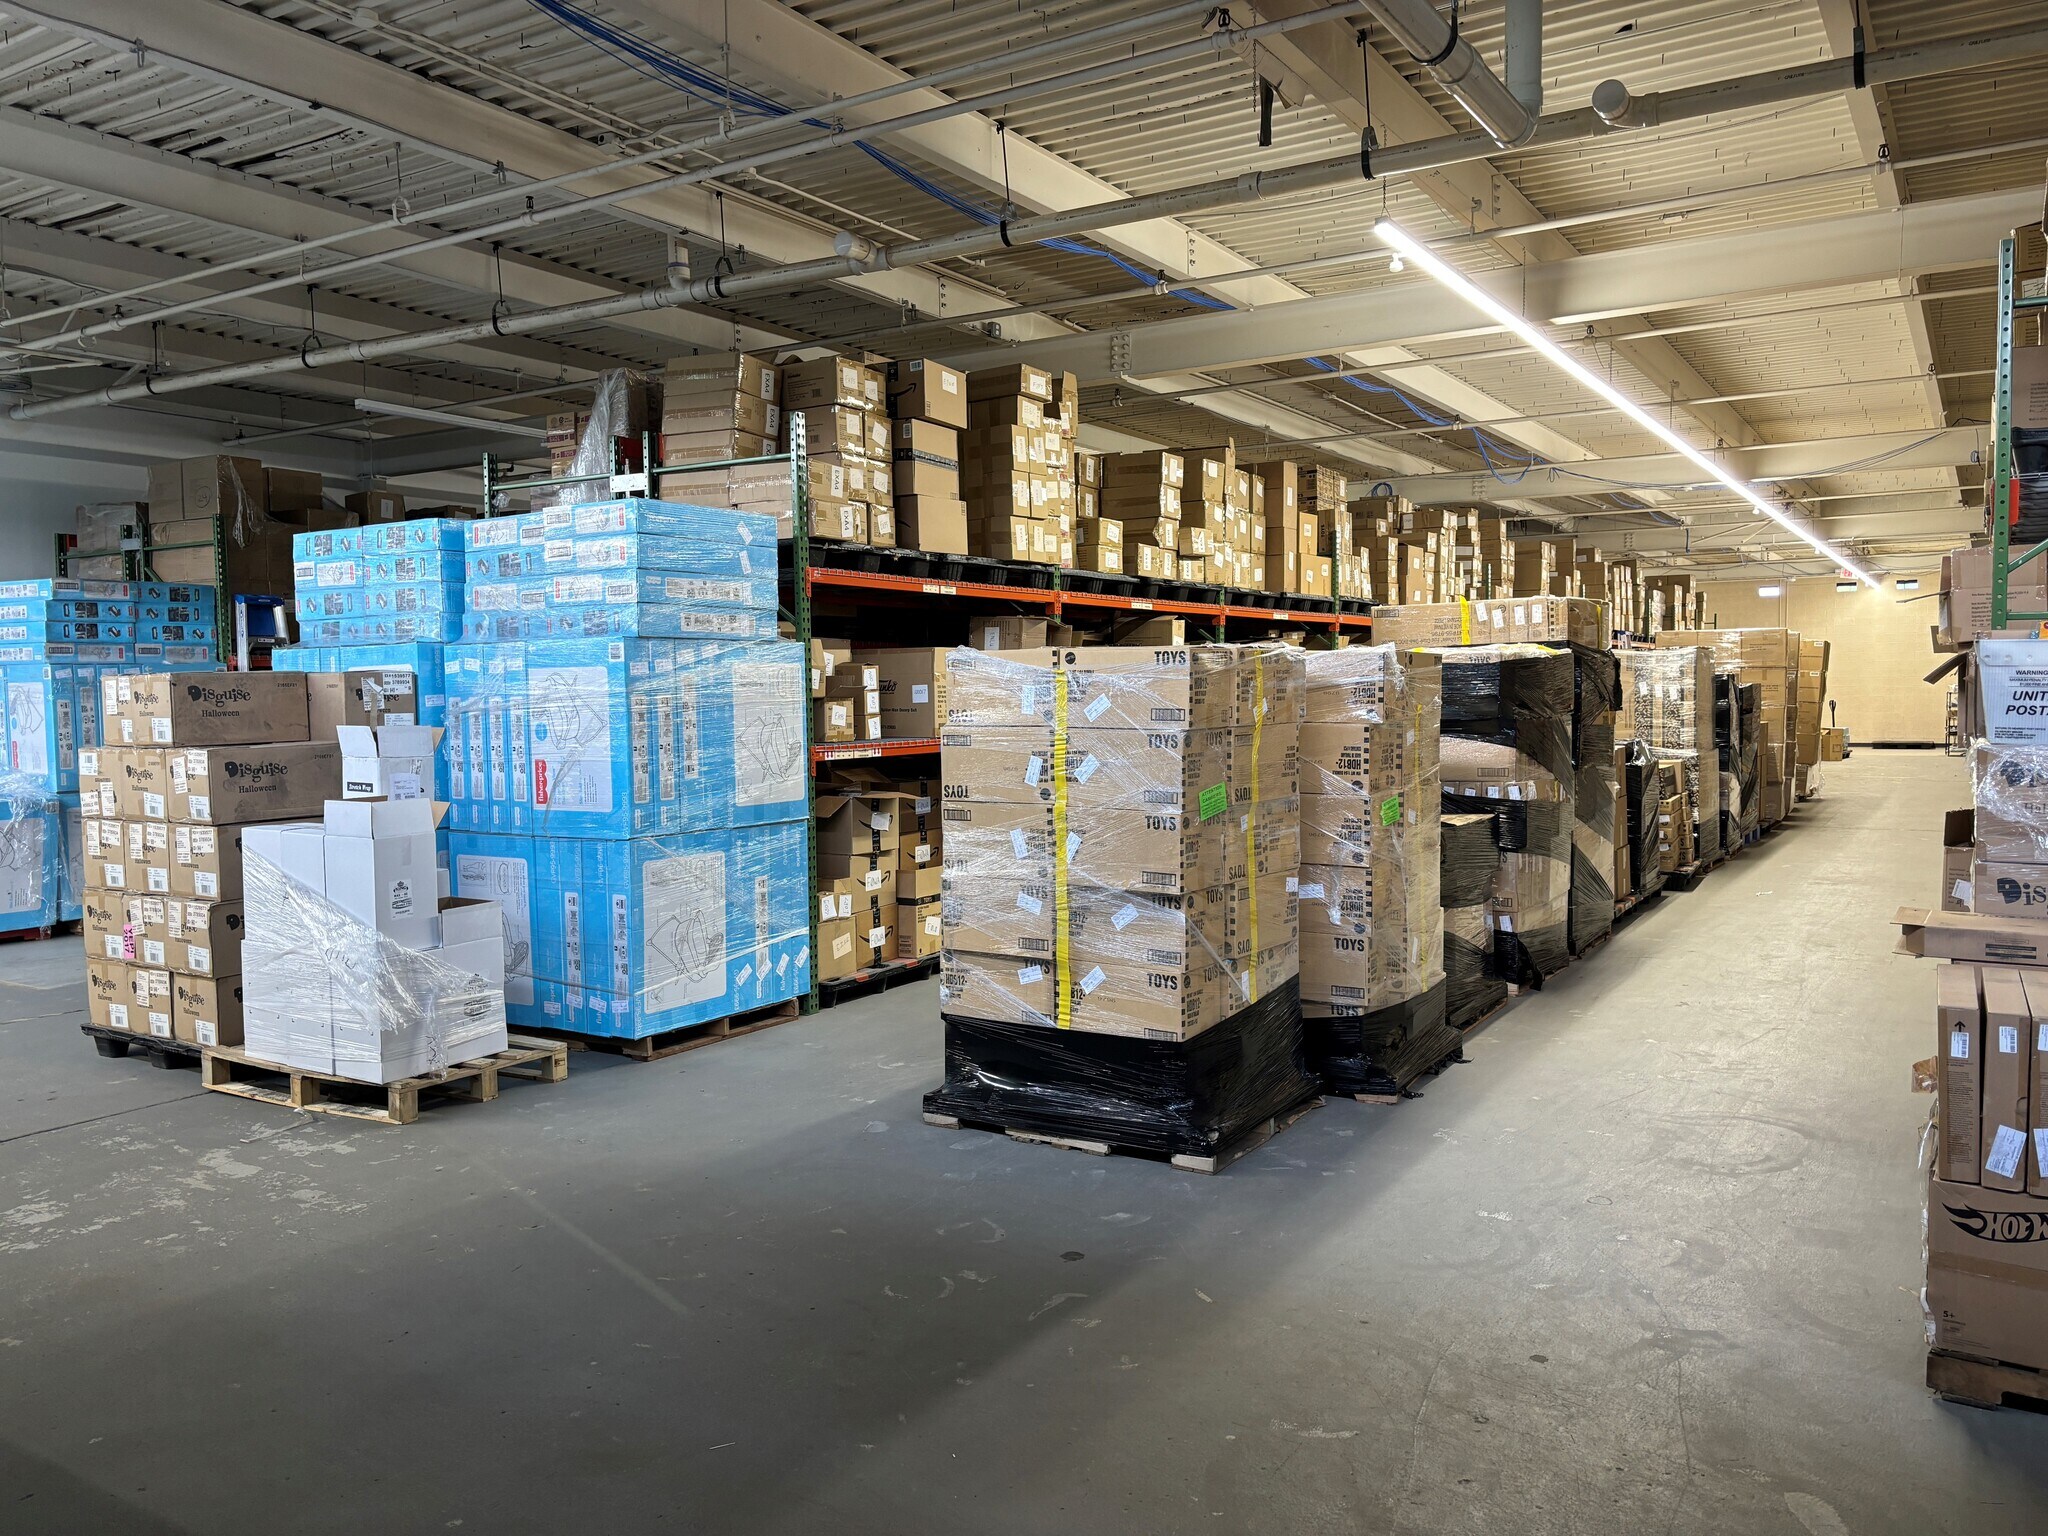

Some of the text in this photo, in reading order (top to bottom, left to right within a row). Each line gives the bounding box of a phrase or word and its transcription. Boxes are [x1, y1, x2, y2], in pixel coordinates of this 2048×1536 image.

[832, 469, 840, 490] EXA4
[1154, 651, 1186, 665] TOYS
[879, 680, 898, 691] unko
[134, 691, 160, 710] Disguise
[188, 685, 251, 707] Disguise
[2012, 691, 2048, 701] UNIT
[2006, 705, 2048, 716] POST
[1147, 734, 1178, 748] TOYS
[1206, 732, 1222, 746] TOYS
[224, 761, 288, 782] Disguise
[1336, 759, 1361, 770] HDB12-
[126, 765, 154, 784] Disguise
[238, 785, 277, 794] Halloween
[944, 785, 969, 798] TOYS
[1235, 787, 1252, 802] TOYS
[1145, 816, 1176, 831] TOYS
[1229, 864, 1246, 880] TOYS
[1151, 896, 1182, 910] TOYS
[1206, 888, 1223, 904] TOYS
[87, 905, 112, 924] Disguise
[1334, 938, 1365, 952] TOYS
[92, 974, 116, 994] Disguise
[1147, 974, 1178, 990] TOYS
[178, 987, 204, 1008] Disguise
[1986, 1213, 2034, 1241] HOT
[1943, 1310, 1955, 1318] 5+
